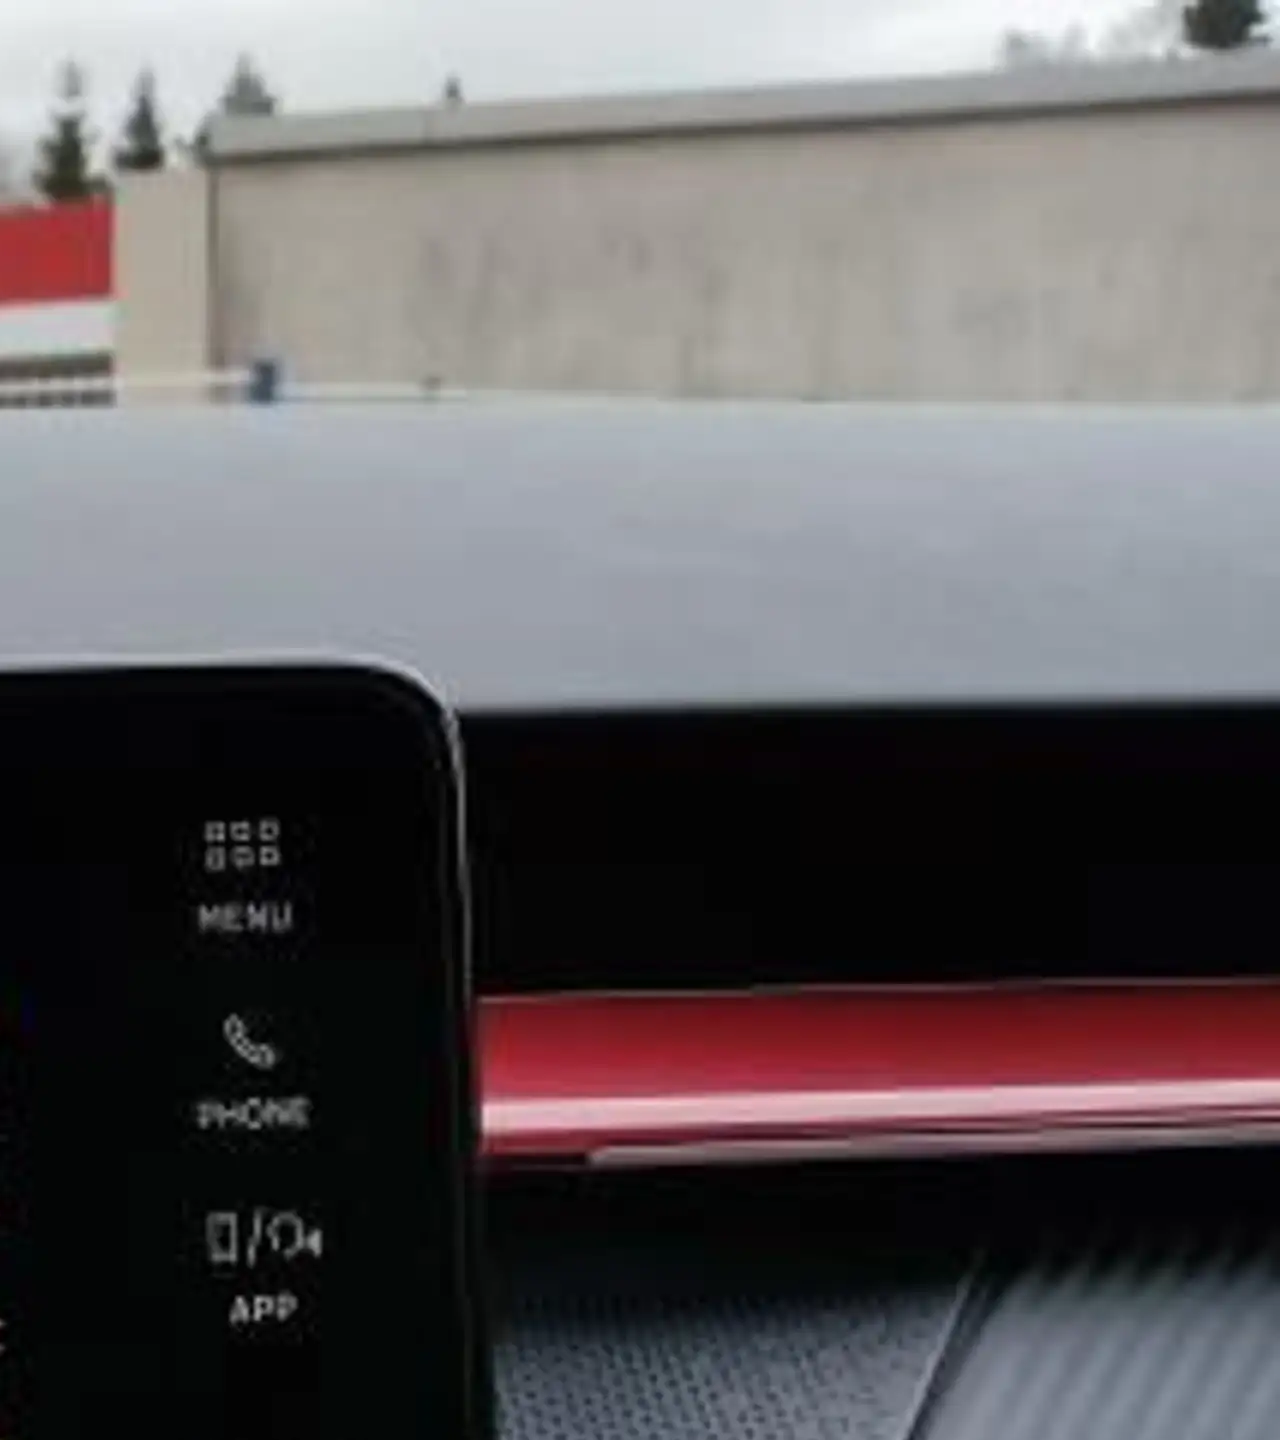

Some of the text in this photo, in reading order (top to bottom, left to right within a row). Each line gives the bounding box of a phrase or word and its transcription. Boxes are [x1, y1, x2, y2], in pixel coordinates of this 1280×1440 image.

[197, 901, 293, 933] MENU
[195, 1096, 310, 1131] PHONE
[229, 1292, 298, 1325] APP
